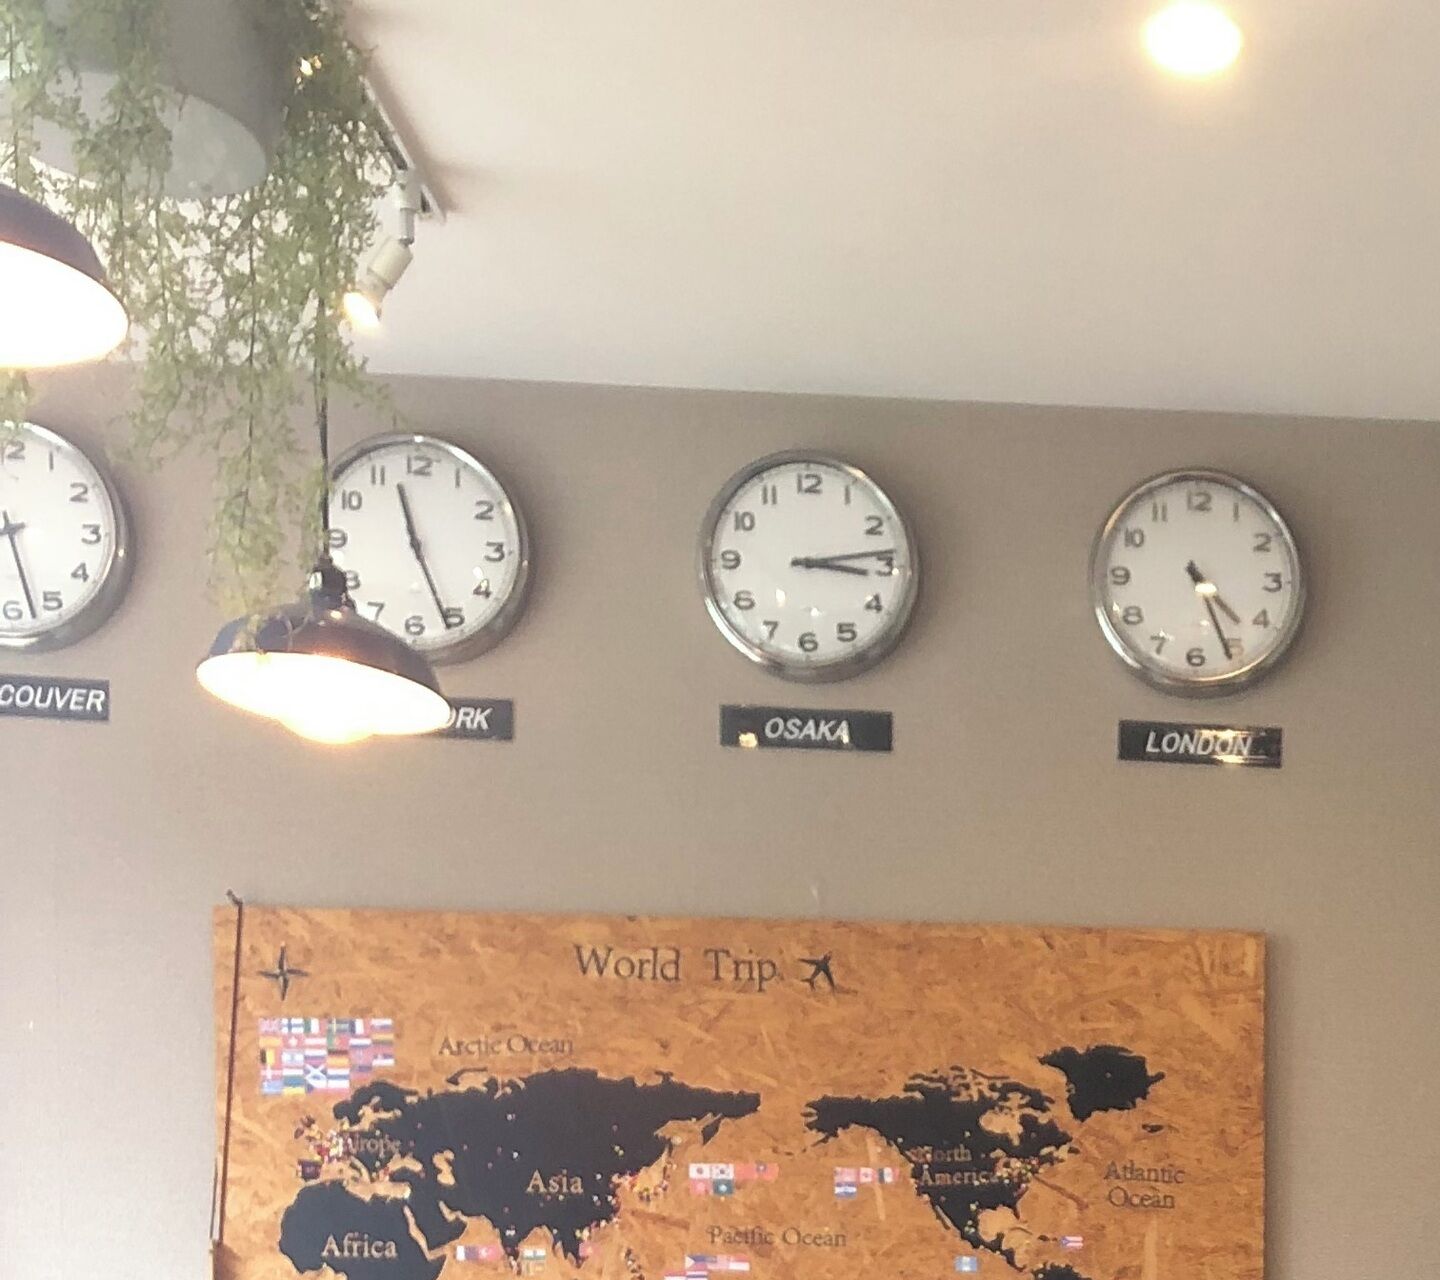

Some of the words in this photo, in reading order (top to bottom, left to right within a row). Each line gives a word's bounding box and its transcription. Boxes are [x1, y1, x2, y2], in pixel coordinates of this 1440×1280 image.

[48, 451, 54, 470] 1
[407, 455, 433, 477] 12
[371, 465, 386, 486] 11
[455, 468, 460, 488] 1
[797, 473, 823, 494] 12
[69, 482, 89, 503] 2
[341, 490, 363, 511] 10
[762, 485, 777, 505] 11
[845, 485, 851, 505] 1
[1187, 492, 1212, 511] 12
[474, 500, 495, 521] 2
[734, 511, 756, 531] 10
[1152, 502, 1168, 522] 11
[1233, 502, 1239, 522] 1
[82, 524, 102, 545] 3
[864, 515, 884, 535] 2
[328, 528, 348, 549] 9
[1124, 528, 1145, 548] 10
[1253, 533, 1271, 552] 2
[484, 541, 505, 562] 3
[720, 550, 741, 570] 9
[71, 562, 90, 583] 4
[875, 552, 895, 576] 3
[345, 570, 361, 590] 8
[1110, 566, 1131, 586] 9
[1263, 572, 1282, 593] 3
[472, 578, 492, 599] 4
[2, 600, 23, 621] 6
[42, 590, 63, 611] 5
[733, 590, 756, 610] 8
[864, 592, 883, 613] 4
[367, 602, 385, 621] 7
[446, 606, 466, 628] 5
[1122, 605, 1143, 625] 8
[1252, 609, 1270, 628] 4
[404, 615, 425, 636] 6
[762, 620, 779, 640] 7
[836, 622, 857, 642] 5
[798, 632, 818, 652] 6
[1150, 635, 1167, 655] 7
[1186, 647, 1206, 667] 6
[765, 717, 850, 742] OSAKA
[1145, 731, 1252, 756] LONDON
[573, 943, 680, 982] World
[703, 948, 778, 993] Trip
[437, 1034, 500, 1058] Arctic
[507, 1034, 574, 1056] Ocean
[527, 1170, 584, 1195] Asia
[1104, 1161, 1186, 1184] Atlantic
[1108, 1187, 1175, 1210] Ocean
[321, 1233, 397, 1259] Africa
[706, 1224, 775, 1245] Pacific
[782, 1226, 847, 1247] Ocean
